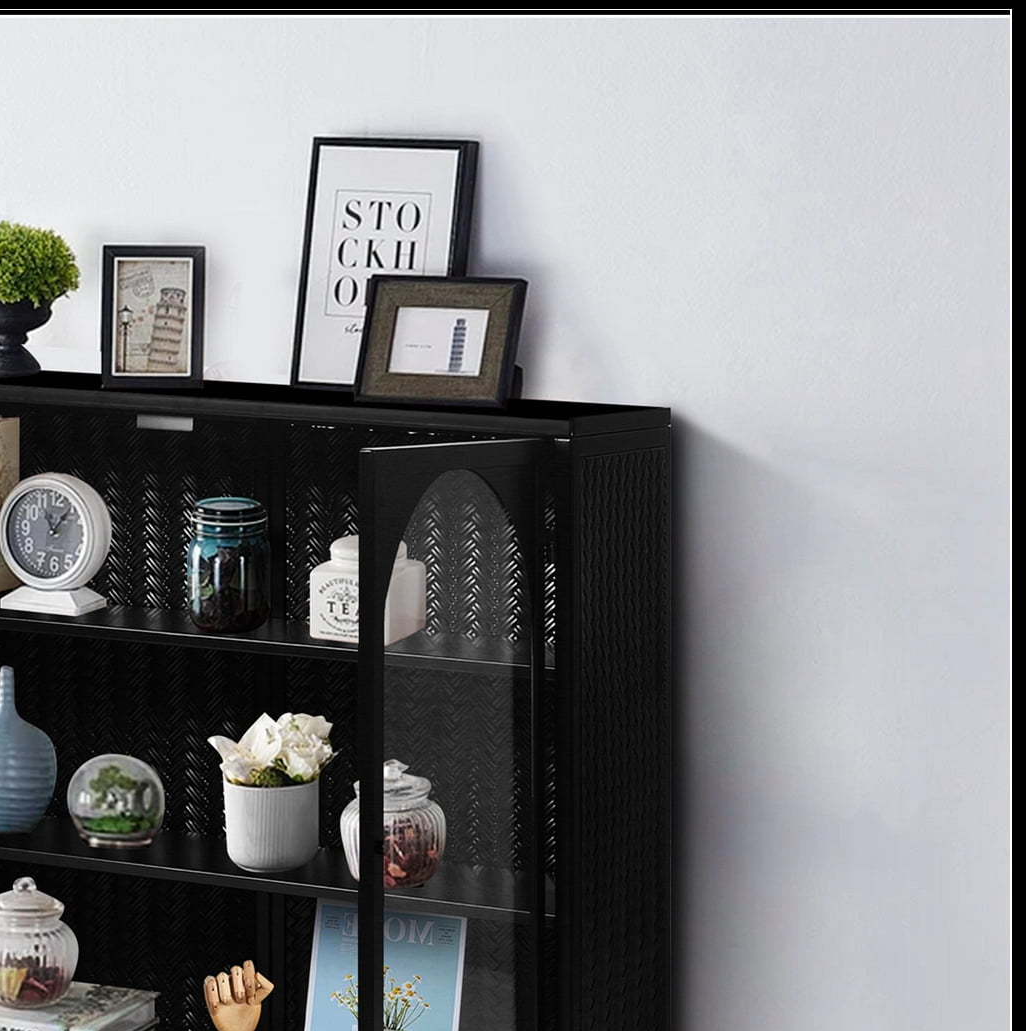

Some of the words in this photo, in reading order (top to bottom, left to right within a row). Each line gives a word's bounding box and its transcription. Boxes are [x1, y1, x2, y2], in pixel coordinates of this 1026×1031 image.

[342, 199, 421, 232] STO
[337, 237, 416, 270] CKH
[50, 492, 64, 507] 12
[25, 504, 39, 521] 10
[21, 519, 31, 536] 9
[24, 537, 34, 554] 8
[37, 551, 46, 567] 7
[49, 555, 59, 572] 6
[63, 554, 73, 569] 5
